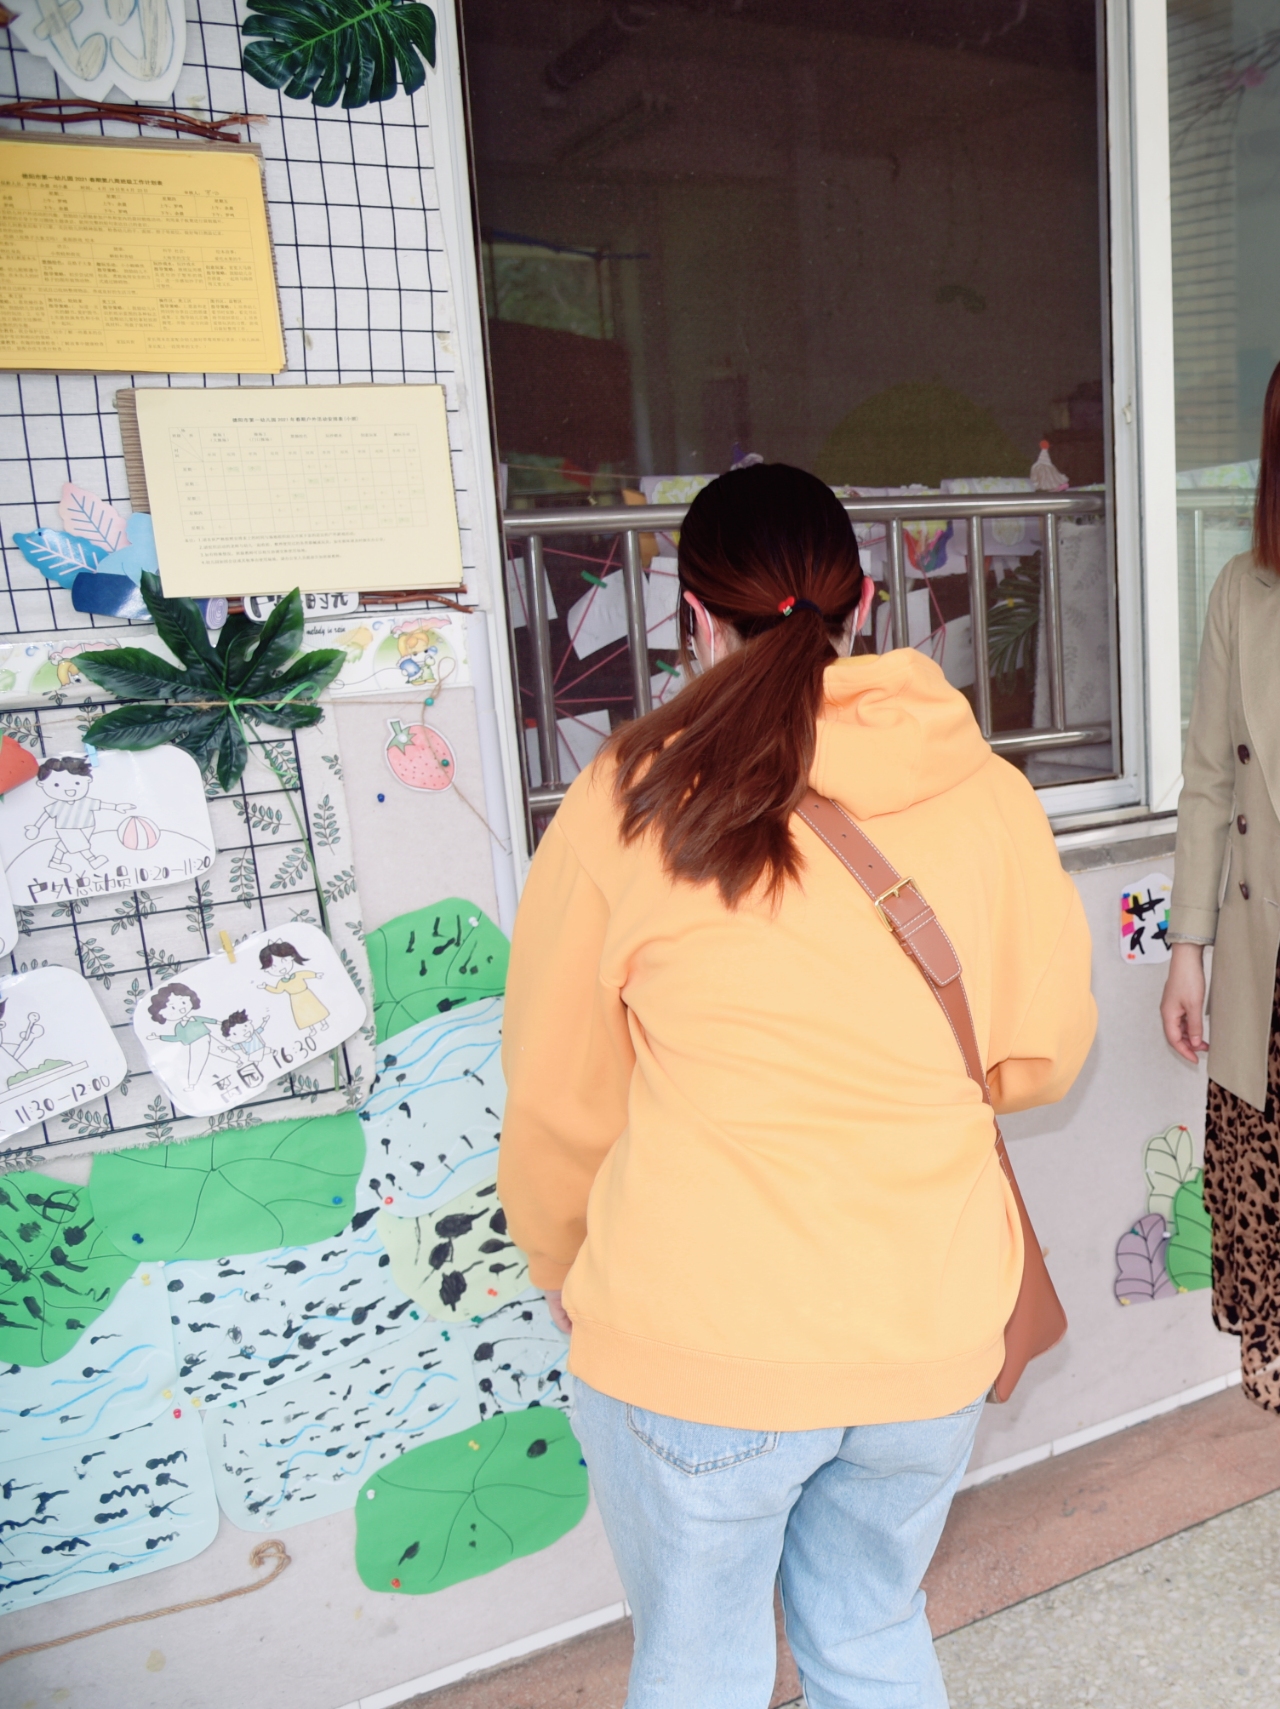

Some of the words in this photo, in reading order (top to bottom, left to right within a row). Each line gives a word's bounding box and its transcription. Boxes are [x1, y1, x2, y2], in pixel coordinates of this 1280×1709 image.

[28, 865, 132, 903] 户外总动员
[212, 1062, 264, 1103] 离园
[273, 1036, 317, 1069] 16:30
